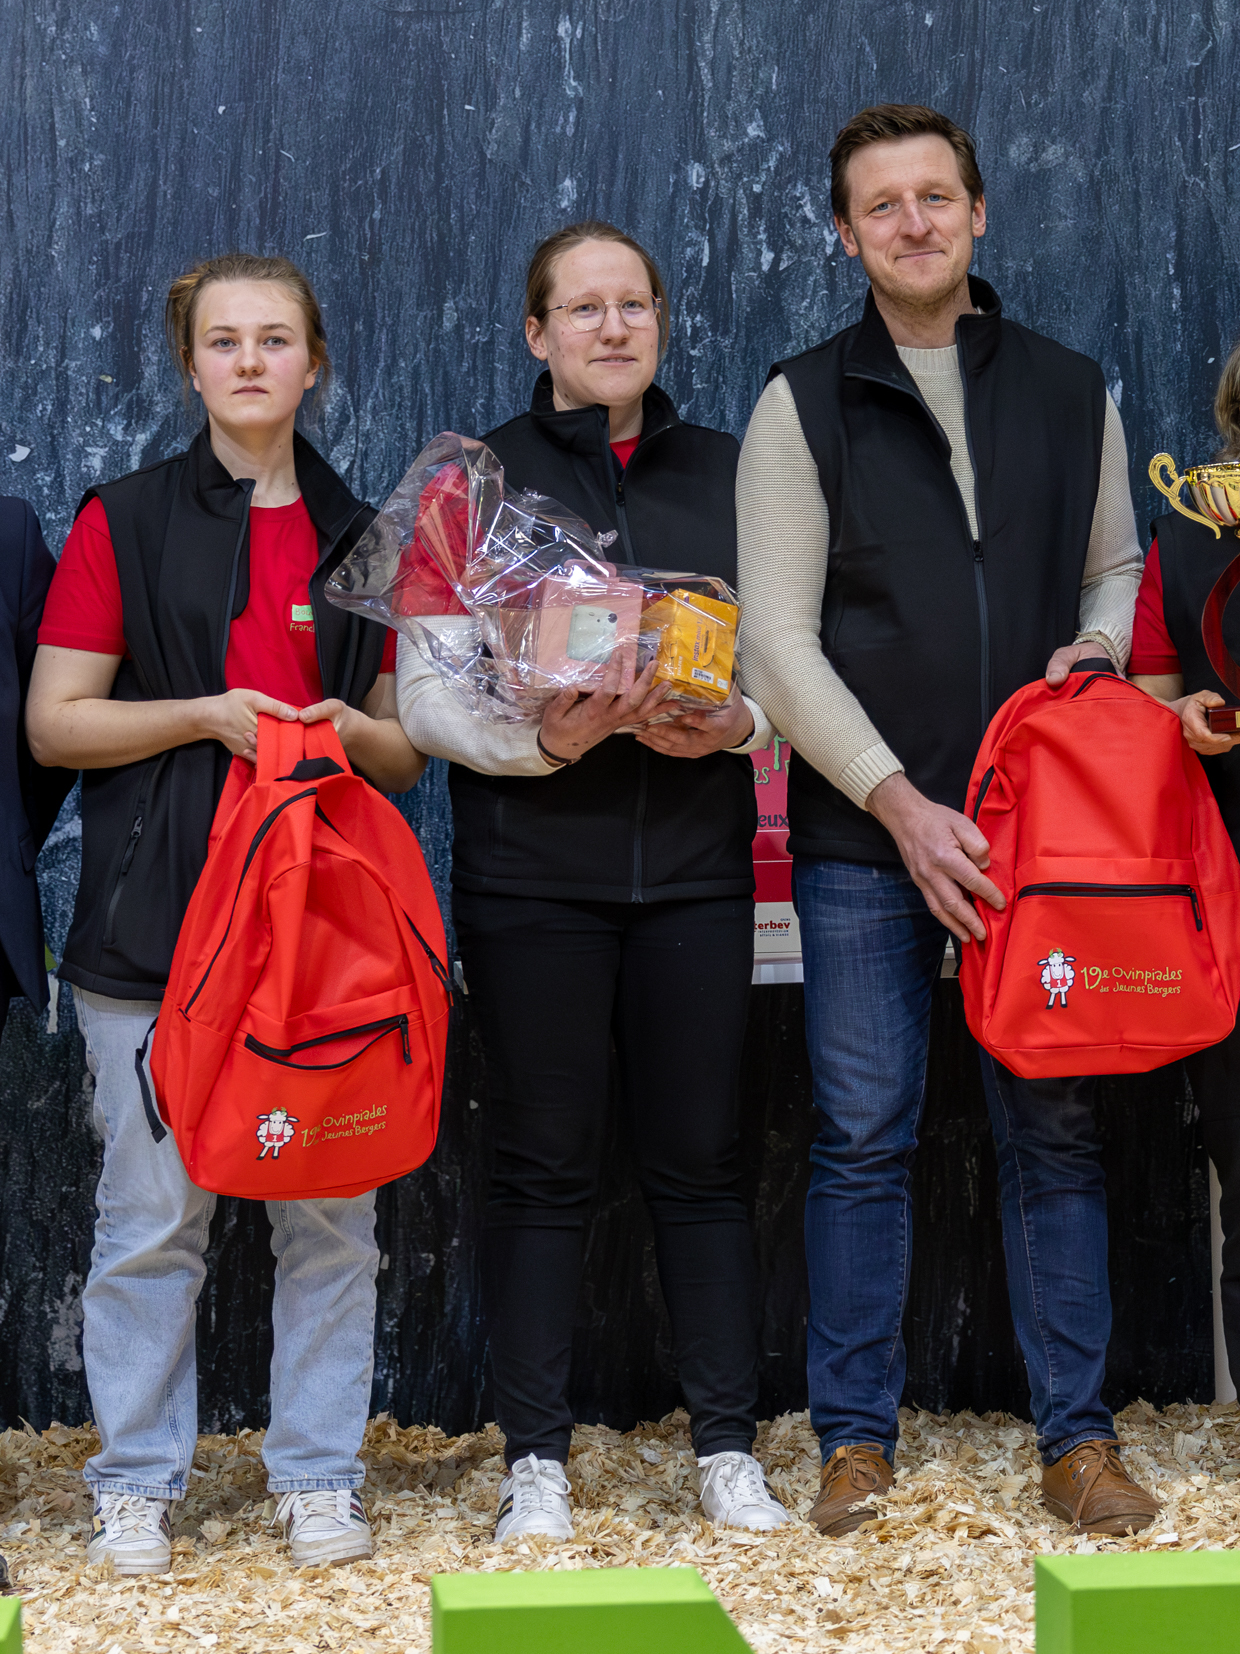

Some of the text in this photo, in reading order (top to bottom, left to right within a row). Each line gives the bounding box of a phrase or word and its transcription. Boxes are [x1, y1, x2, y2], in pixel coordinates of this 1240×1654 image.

[1081, 966, 1183, 990] 19e Ovinpiades
[1113, 982, 1146, 994] Jeunes
[1147, 984, 1181, 997] Bergers
[323, 1104, 387, 1128] Ovinpiades
[321, 1130, 354, 1142] Jeunes
[354, 1121, 386, 1136] Bergers
